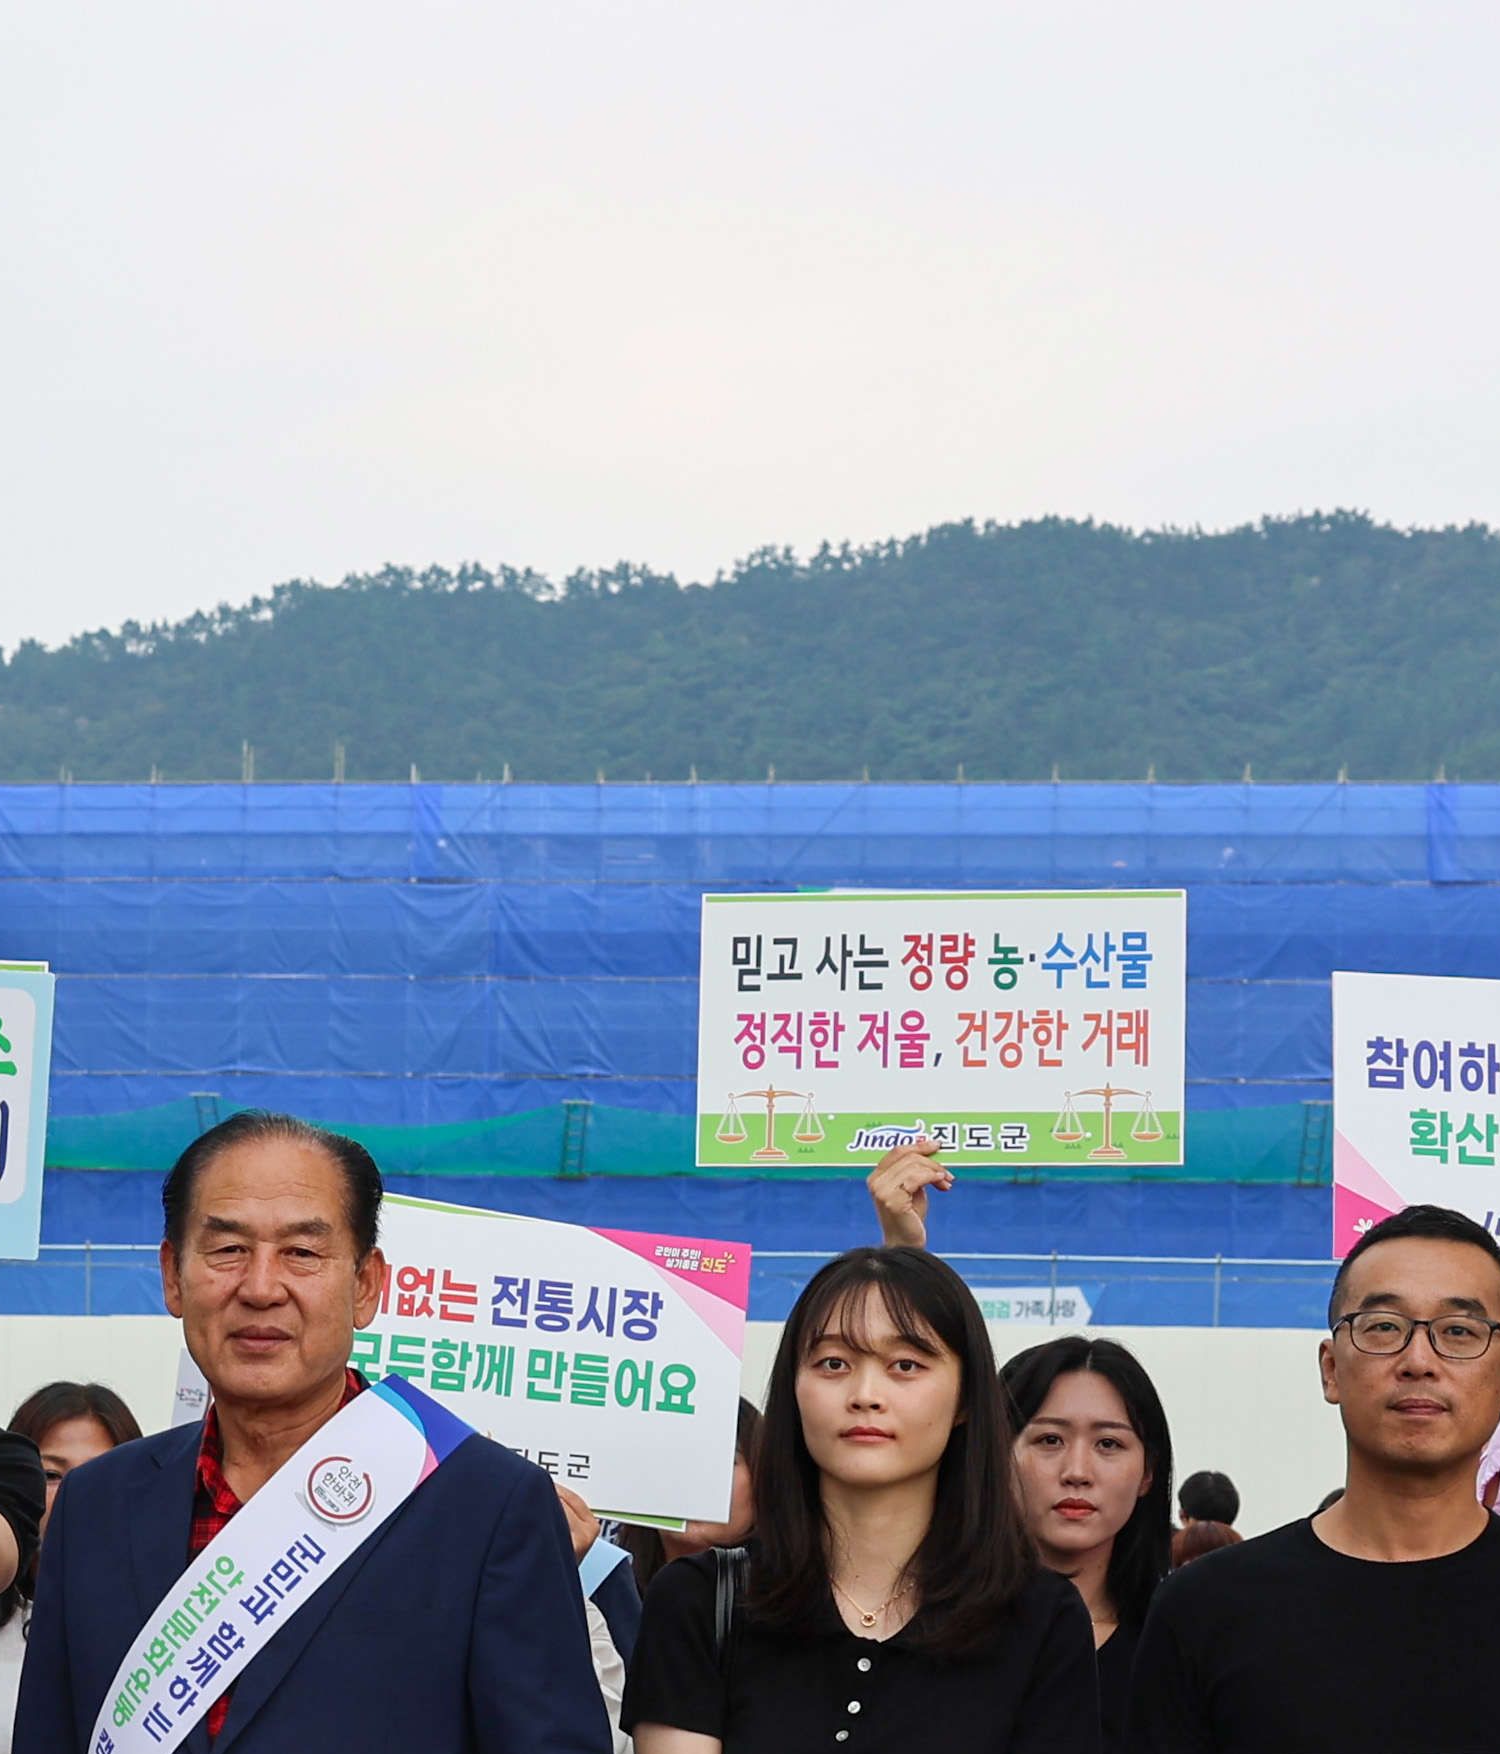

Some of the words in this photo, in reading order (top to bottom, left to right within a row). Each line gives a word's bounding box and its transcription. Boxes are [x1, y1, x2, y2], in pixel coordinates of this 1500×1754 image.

[732, 935, 803, 992] 믿고
[816, 934, 889, 991] 사는
[901, 933, 975, 991] 정량
[988, 932, 1153, 990] 농·수산물
[734, 1012, 845, 1070] 정직한
[857, 1010, 943, 1068] 저울,
[956, 1010, 1068, 1068] 건강한
[1082, 1010, 1149, 1067] 거래
[850, 1128, 914, 1151] Jindo
[933, 1124, 1028, 1151] 진도군
[701, 1257, 727, 1274] 진도
[491, 1276, 663, 1341] 전통시장
[526, 1348, 696, 1414] 만들어요
[322, 1472, 357, 1507] 한바퀴
[338, 1466, 363, 1492] 안전
[239, 1533, 326, 1625] 군민과
[112, 1556, 245, 1727] 안전문화운동
[142, 1621, 245, 1743] 함께하는
